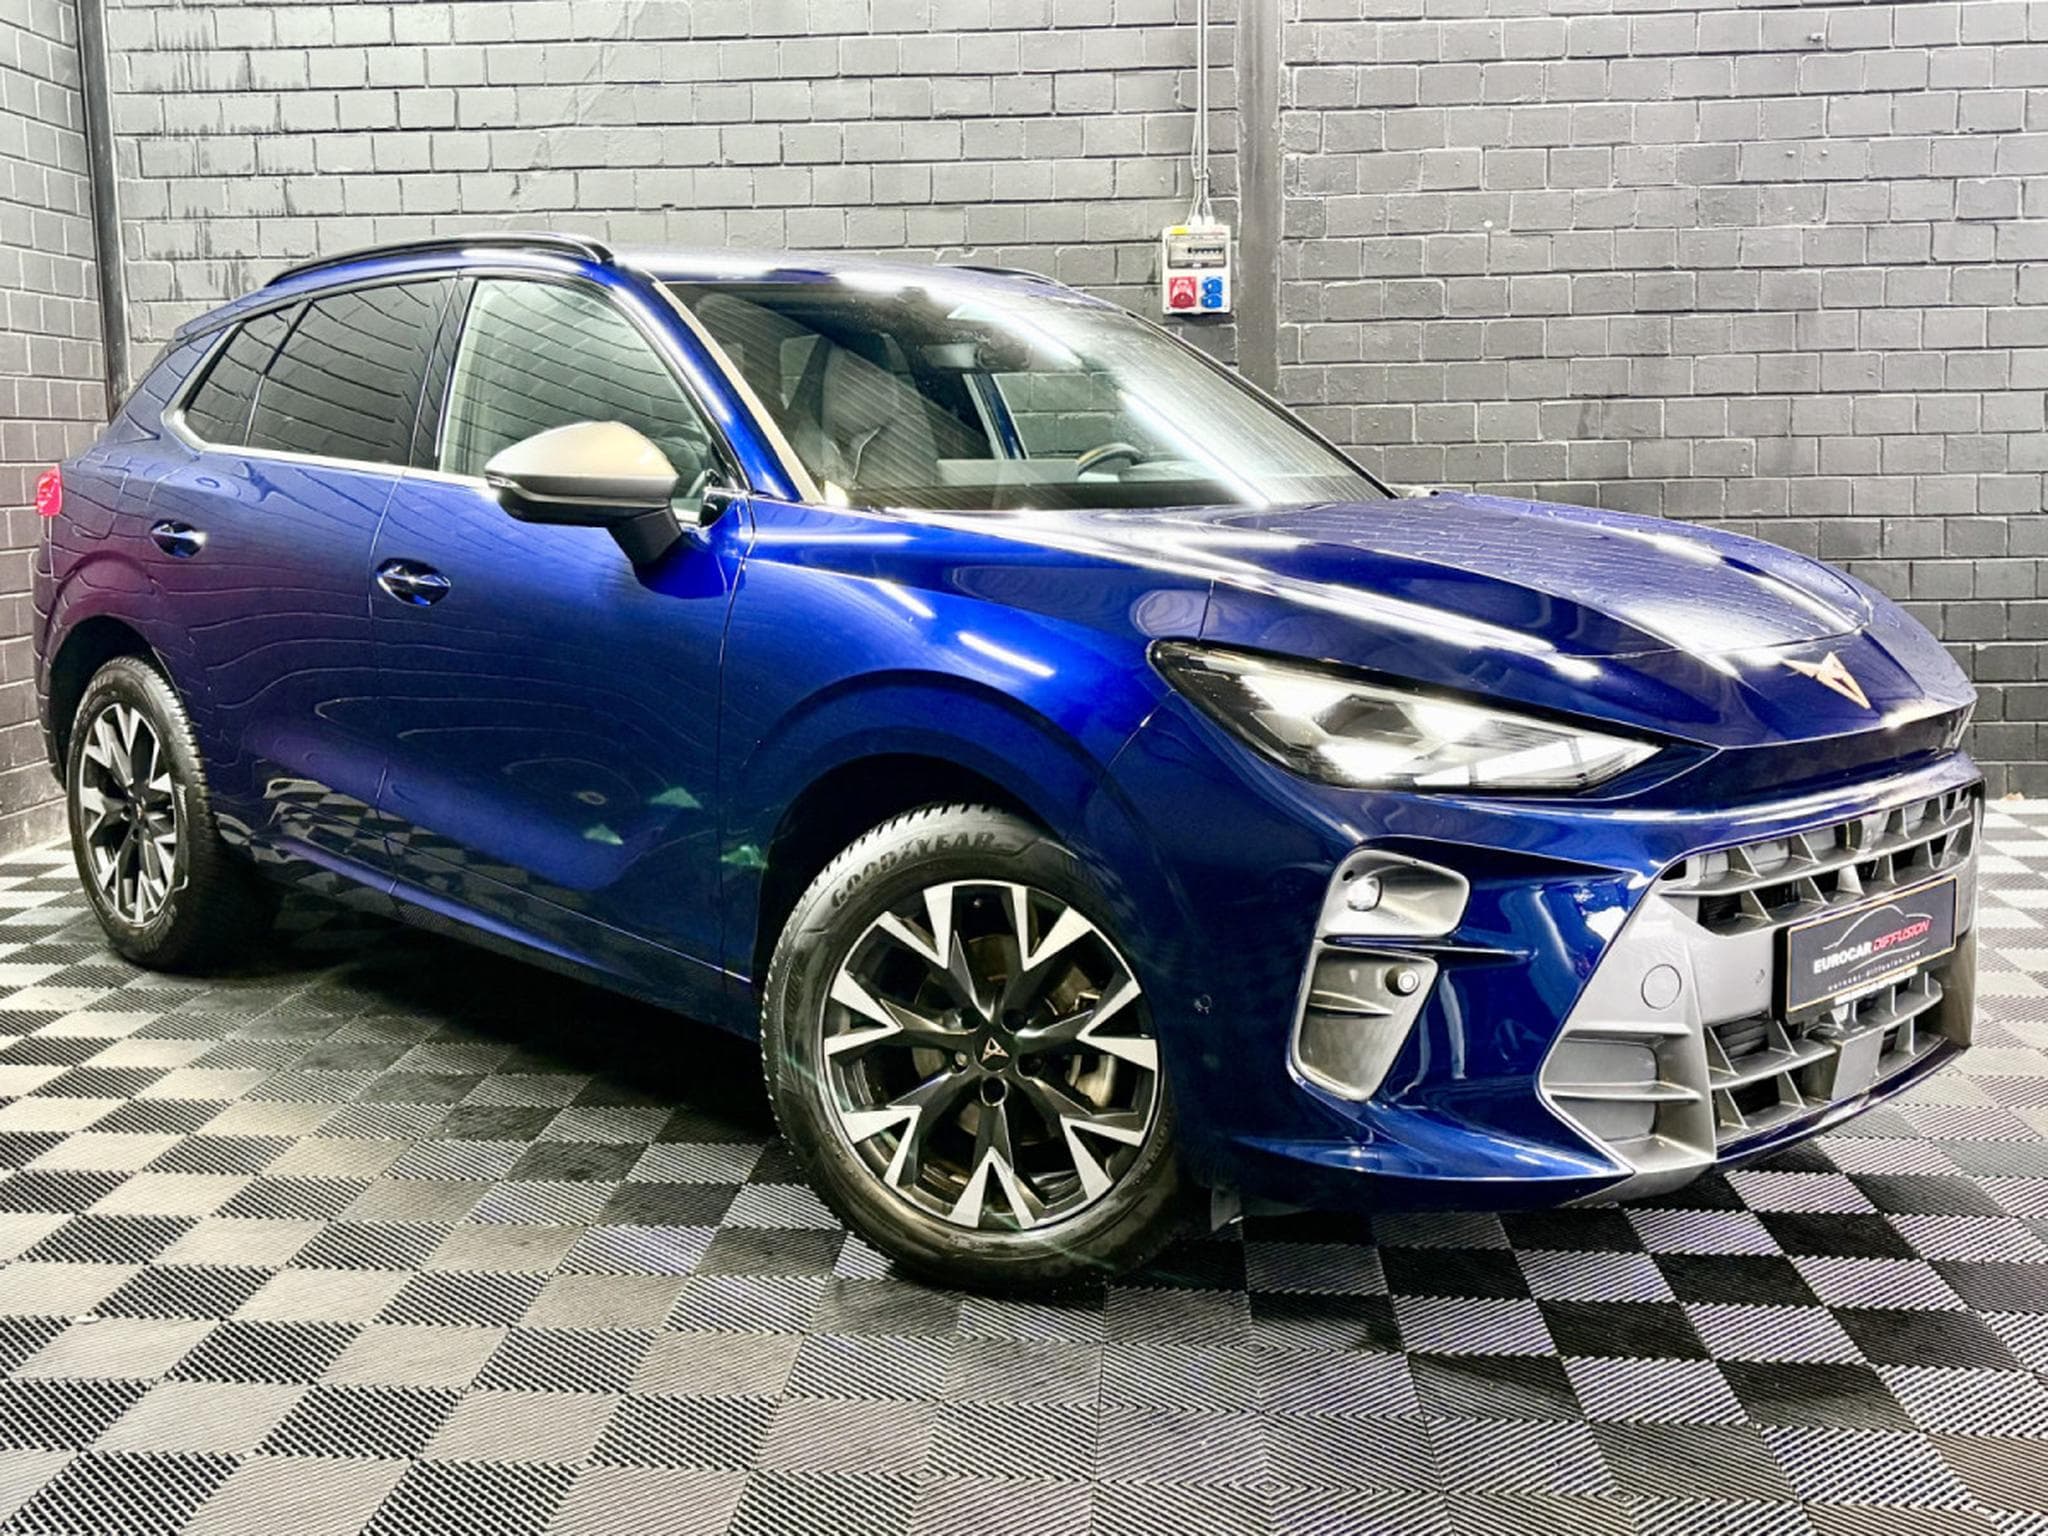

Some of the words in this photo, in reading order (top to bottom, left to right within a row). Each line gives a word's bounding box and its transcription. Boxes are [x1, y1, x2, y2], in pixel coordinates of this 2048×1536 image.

[831, 831, 995, 908] GOODYEAR
[1813, 941, 1873, 975] EUROCAR
[1873, 919, 1931, 951] DIFFUSION
